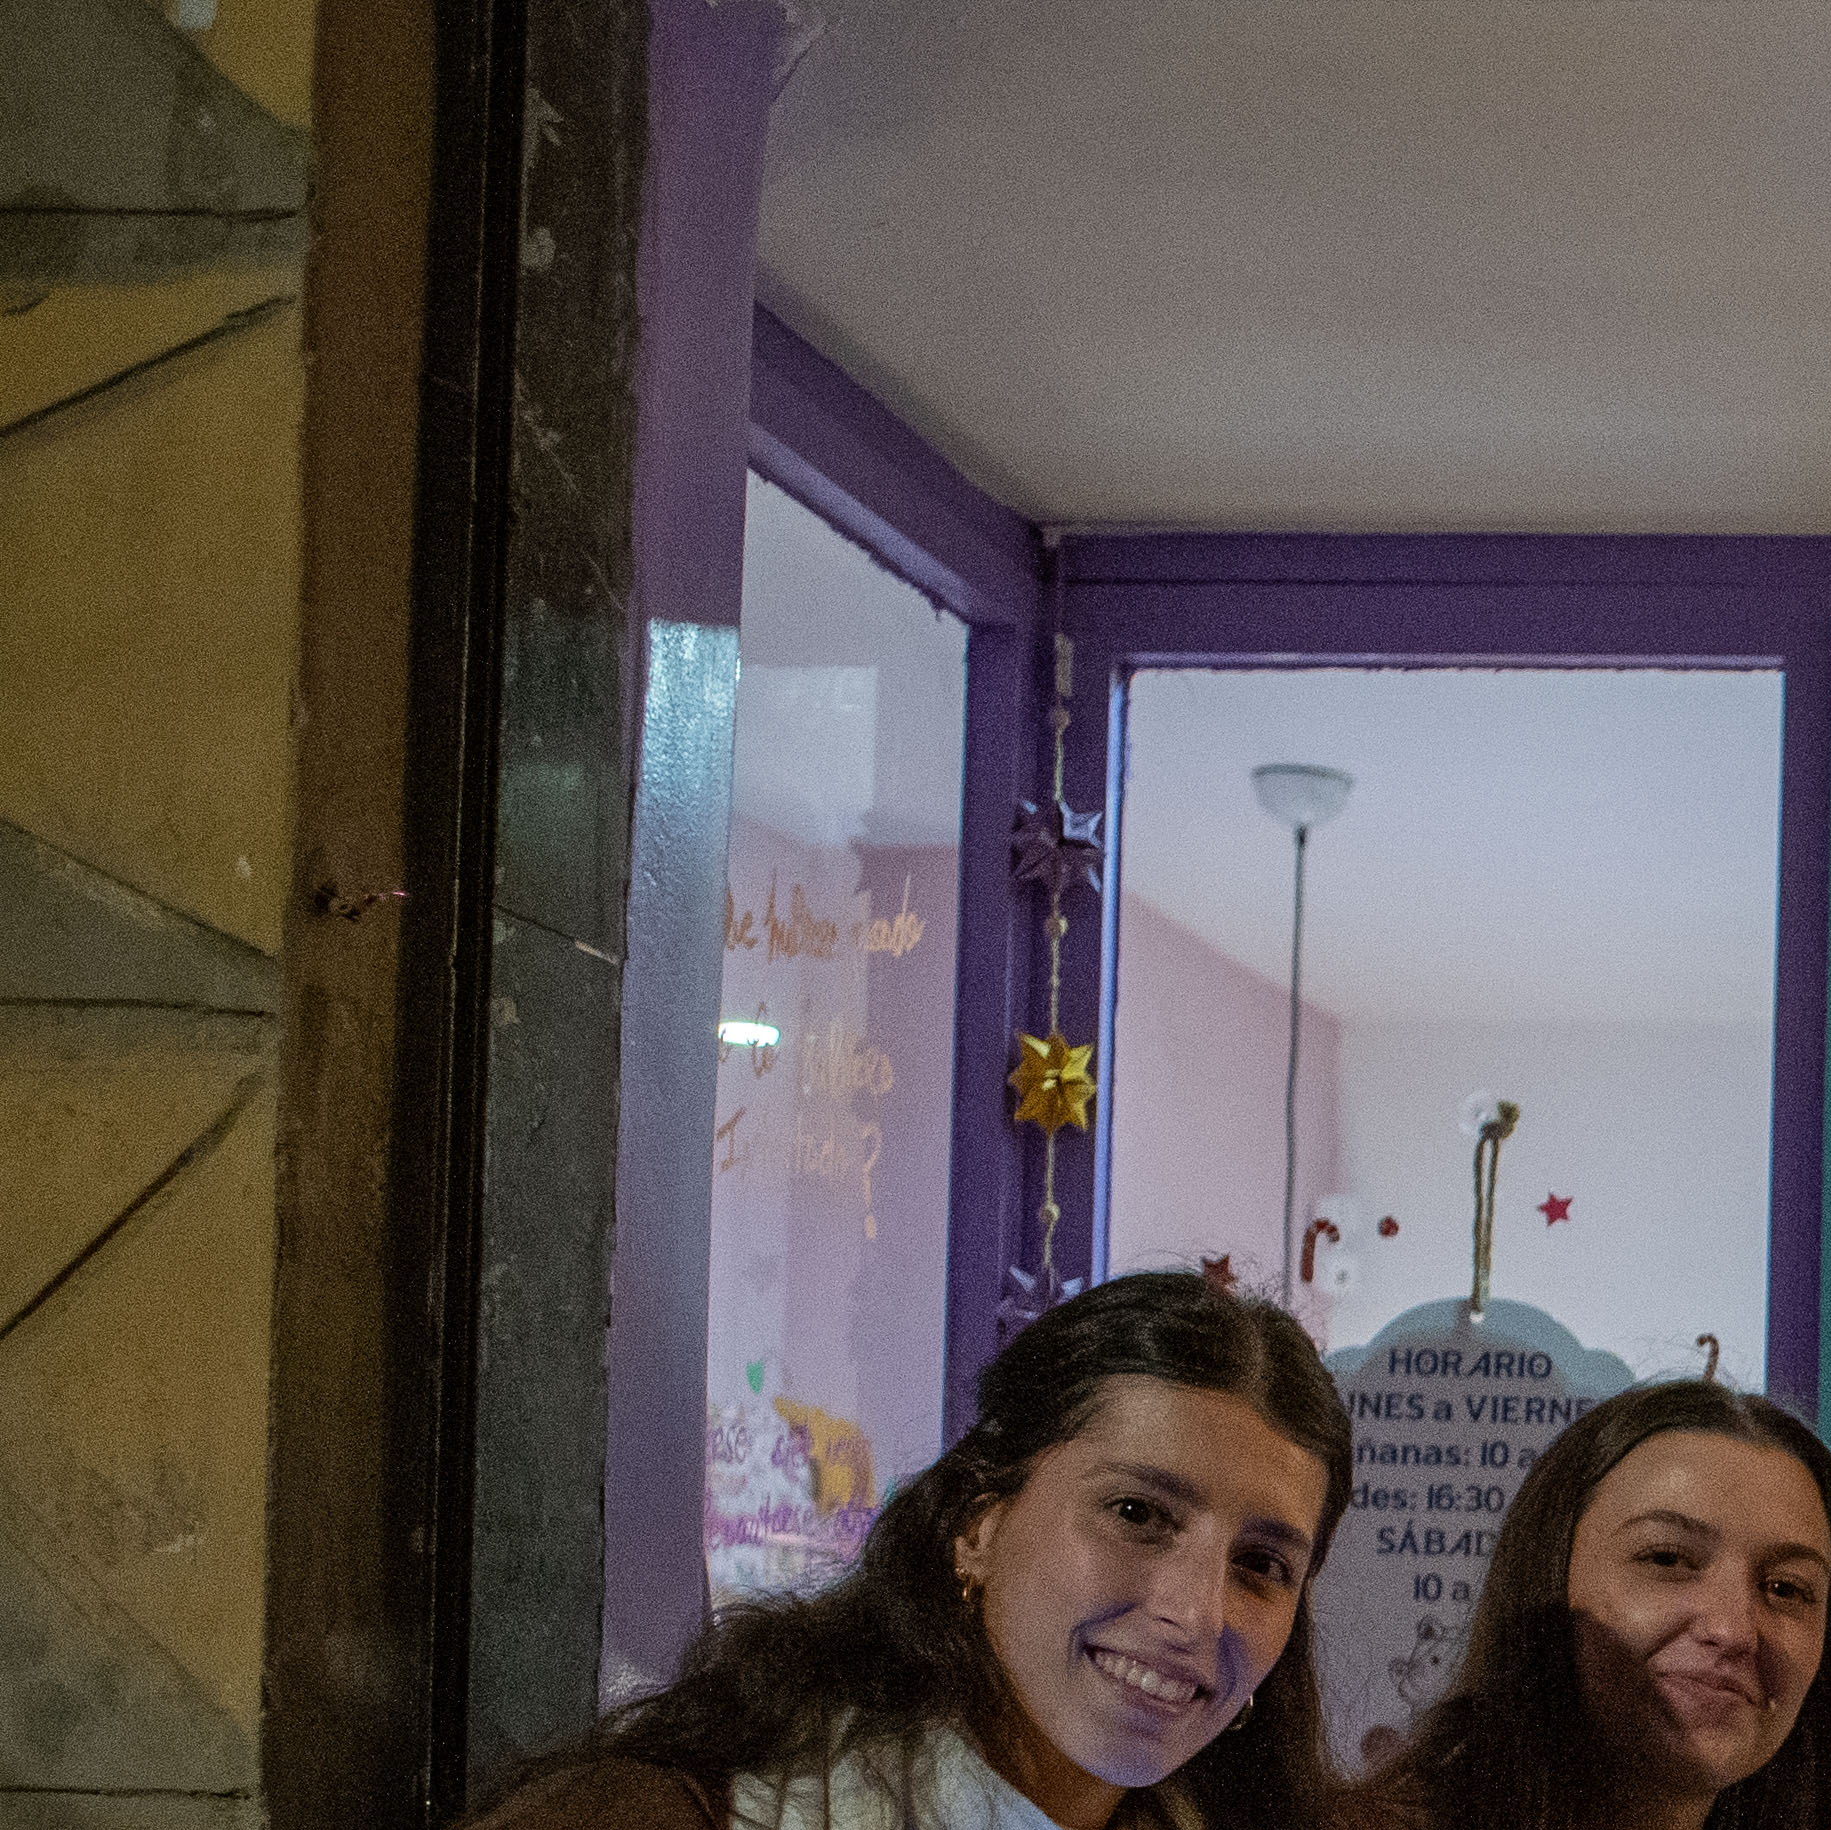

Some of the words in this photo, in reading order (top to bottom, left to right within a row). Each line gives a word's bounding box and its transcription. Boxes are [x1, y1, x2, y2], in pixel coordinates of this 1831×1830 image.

[1388, 1350, 1552, 1379] HORARIO
[1350, 1393, 1425, 1421] NES
[1466, 1394, 1598, 1424] VIERNE
[1354, 1439, 1470, 1467] ñanas:
[1479, 1440, 1509, 1468] 10
[1351, 1482, 1417, 1511] des:
[1376, 1518, 1494, 1556] SÁBAD
[1413, 1572, 1442, 1601] 10
